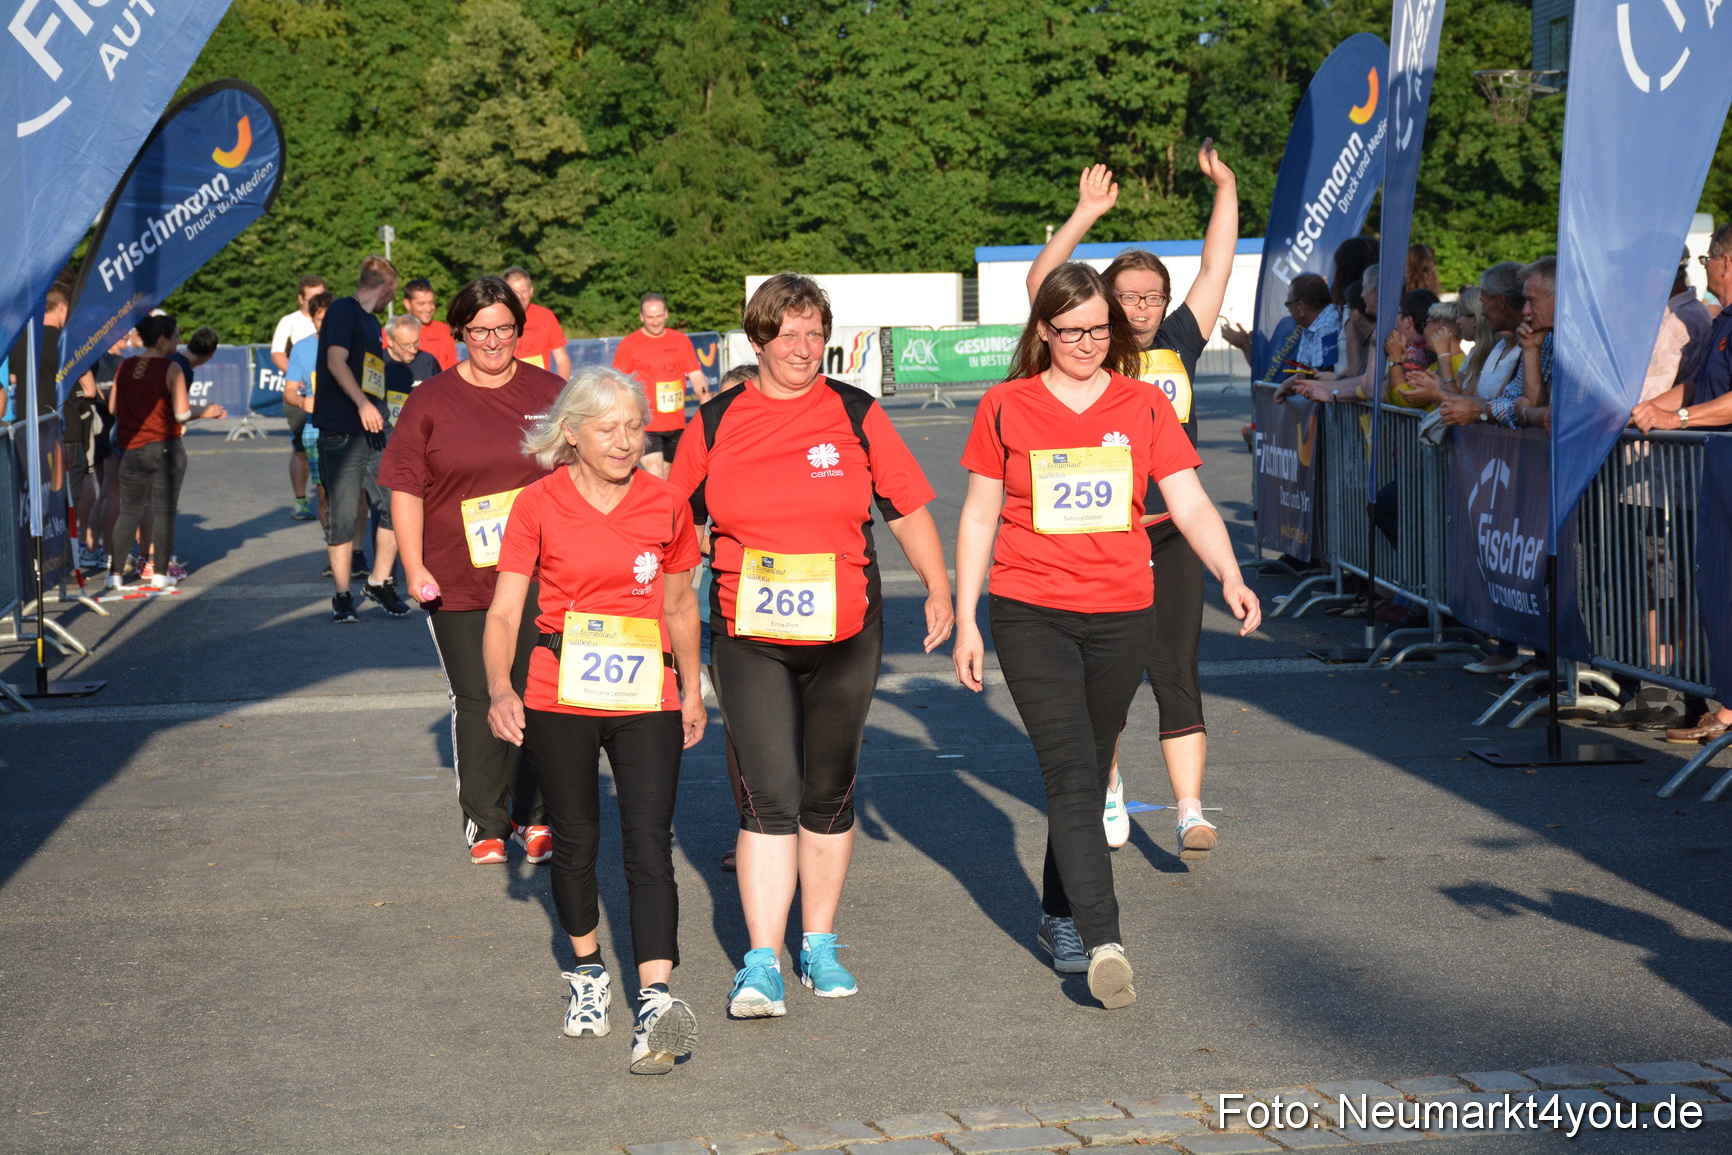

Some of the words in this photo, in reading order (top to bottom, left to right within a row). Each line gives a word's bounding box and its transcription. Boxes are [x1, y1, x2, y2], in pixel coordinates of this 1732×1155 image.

[1337, 176, 1360, 214] Druck
[1356, 153, 1371, 180] und
[184, 209, 216, 241] Druck
[235, 161, 273, 200] Medien
[1271, 131, 1364, 286] Frischmann
[98, 172, 230, 293] Frischmann
[900, 338, 941, 365] AOK
[969, 355, 979, 368] IN
[368, 370, 382, 387] 756
[810, 468, 844, 478] caritas
[1046, 461, 1082, 470] firmenlauf
[1053, 480, 1113, 510] 259
[1478, 512, 1544, 581] Fischer
[755, 586, 815, 617] 268
[579, 628, 617, 639] firmenlauf
[580, 652, 645, 684] 267
